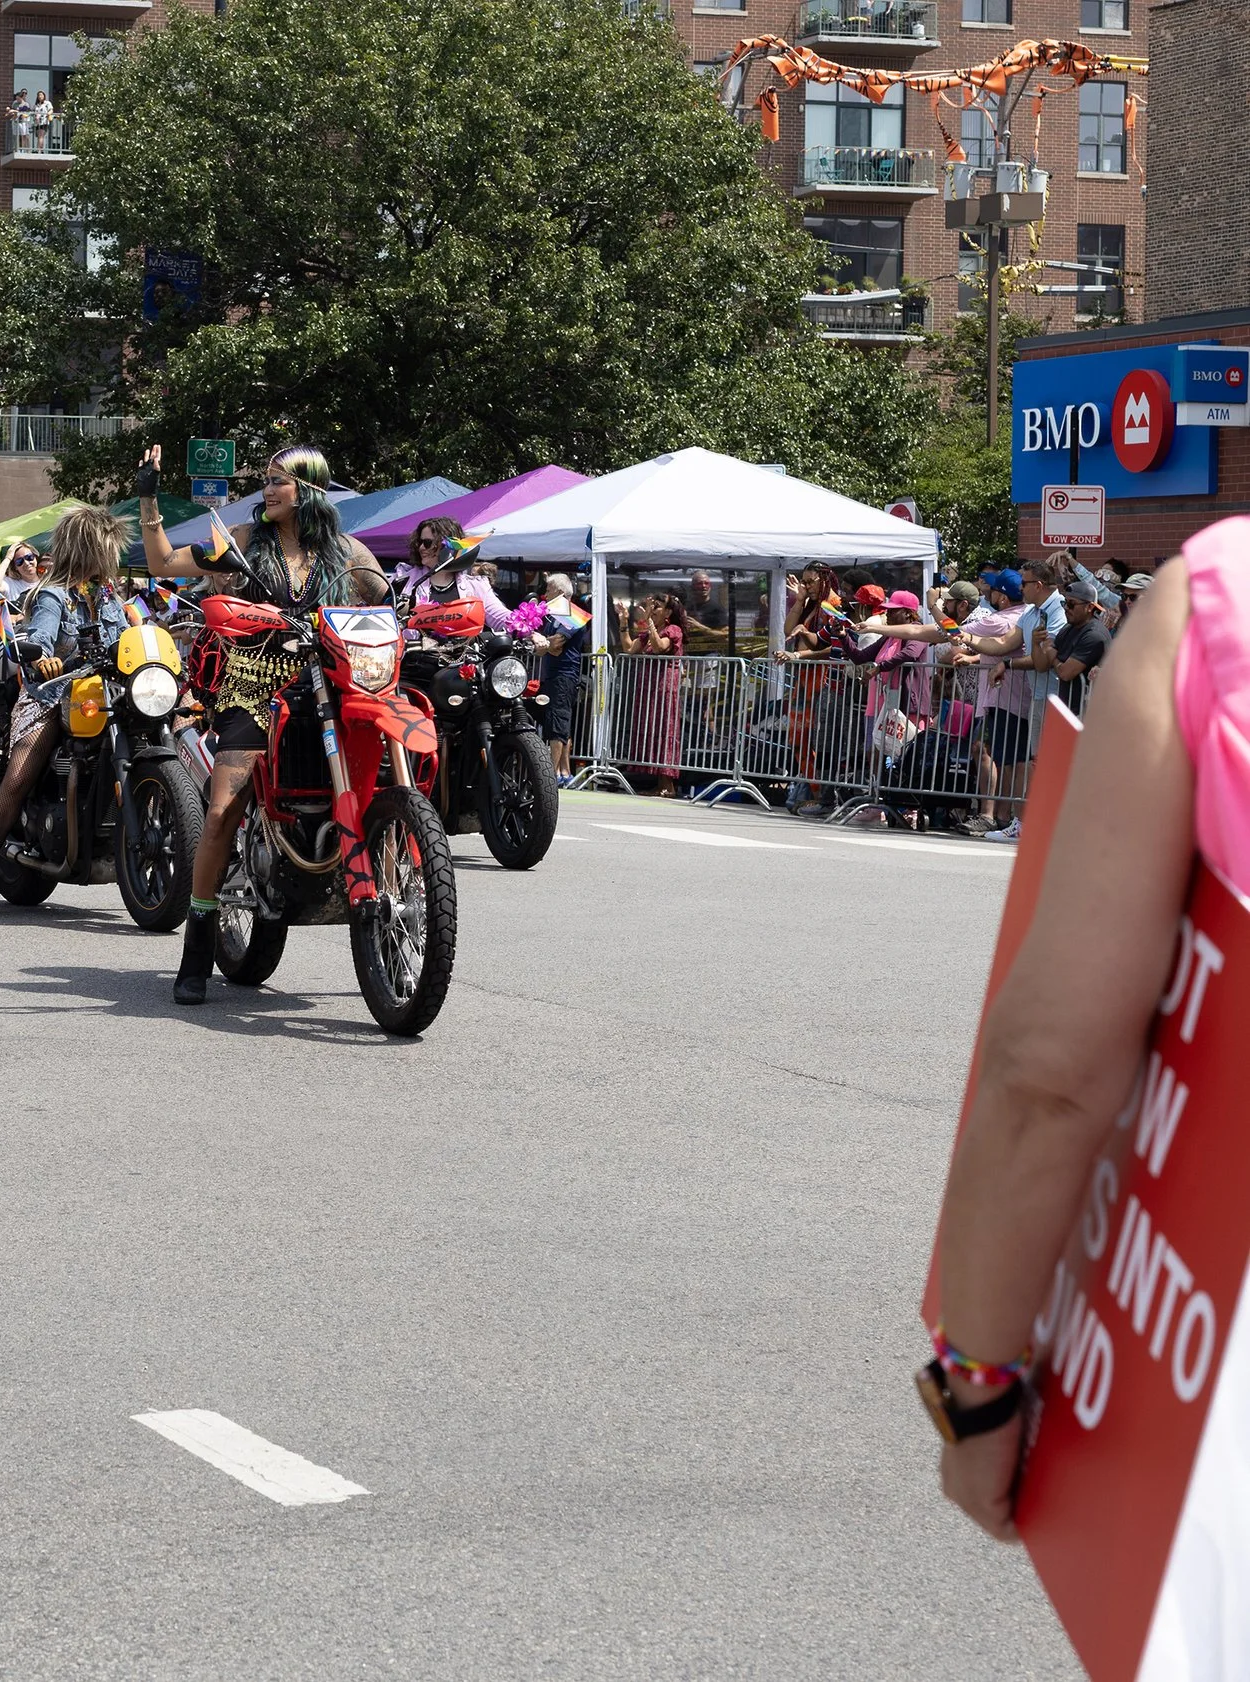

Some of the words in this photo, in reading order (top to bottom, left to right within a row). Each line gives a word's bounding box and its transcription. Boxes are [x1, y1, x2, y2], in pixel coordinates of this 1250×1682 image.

[1192, 370, 1222, 382] BMO
[1207, 407, 1230, 420] ATM
[1022, 402, 1101, 452] BMO
[1048, 535, 1068, 544] TOW
[1070, 535, 1099, 544] ZONE
[236, 612, 283, 627] ACERBIS
[1107, 1194, 1218, 1403] INTO
